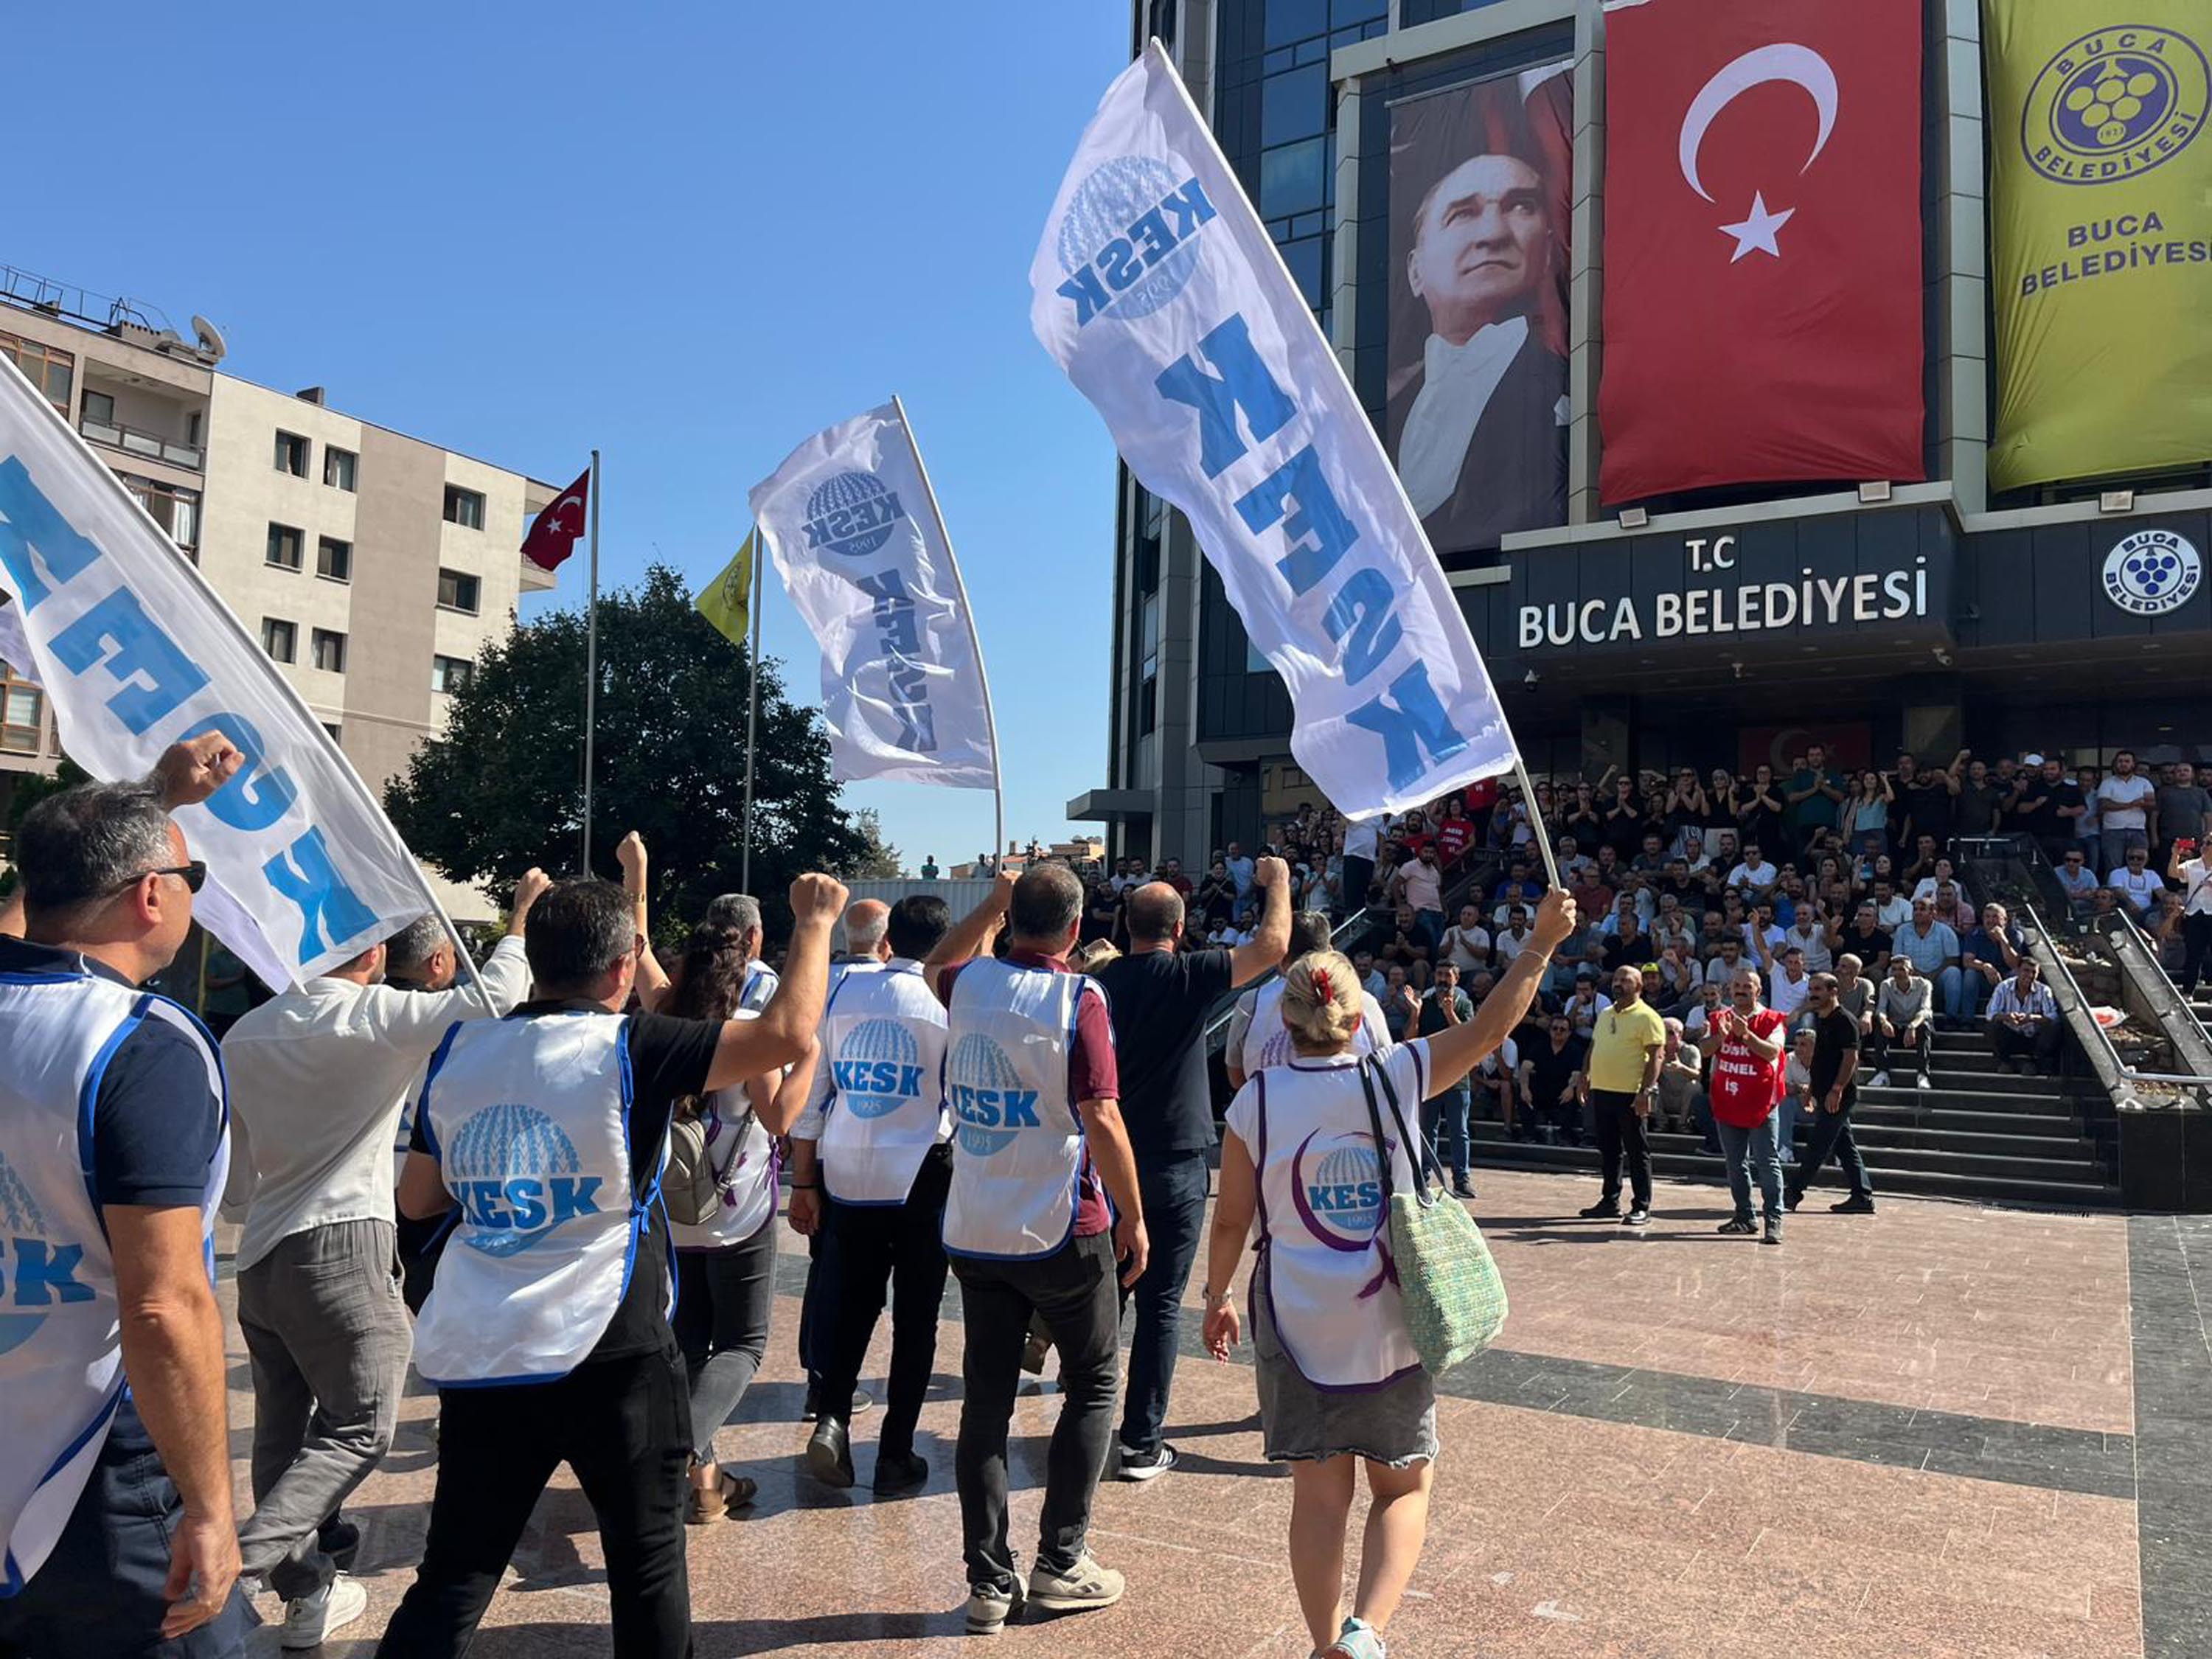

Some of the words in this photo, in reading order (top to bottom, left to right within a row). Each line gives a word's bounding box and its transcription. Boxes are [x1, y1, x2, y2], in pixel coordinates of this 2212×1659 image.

[2056, 33, 2166, 75] BUCA
[2034, 111, 2197, 178] BELEDİYESİ
[2068, 211, 2163, 248] BUCA
[1686, 536, 1736, 572] T.C
[2122, 533, 2179, 552] BUCA
[1518, 597, 1642, 649] BUCA
[1656, 556, 1927, 637] BELEDİYESİ
[833, 1061, 924, 1096] KESK
[1308, 1182, 1381, 1209] KES
